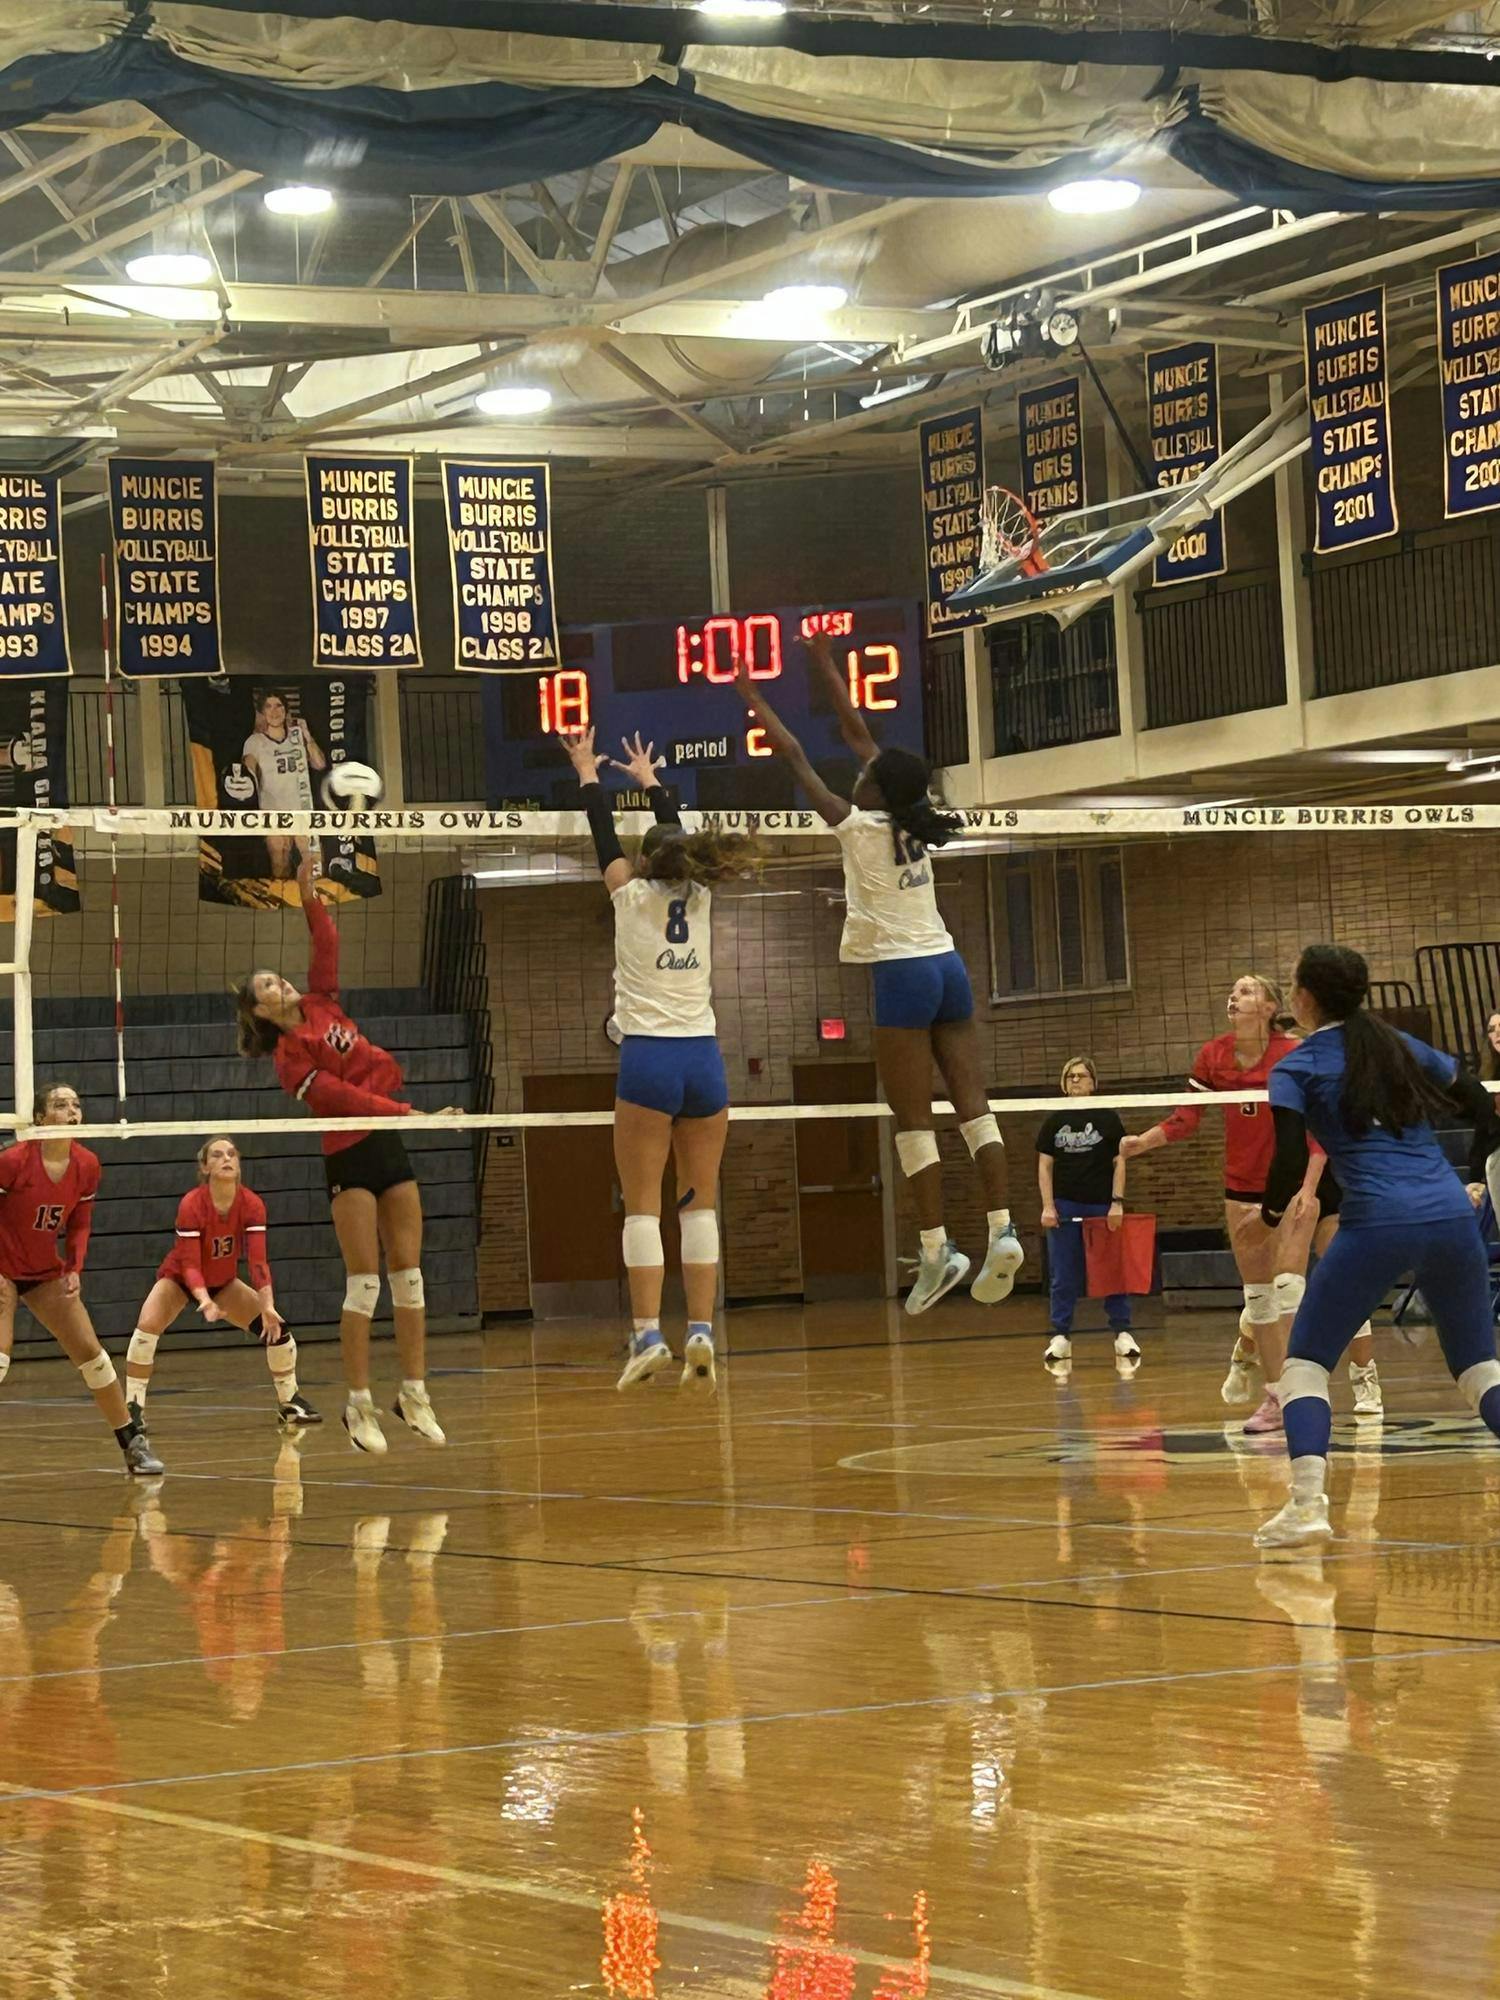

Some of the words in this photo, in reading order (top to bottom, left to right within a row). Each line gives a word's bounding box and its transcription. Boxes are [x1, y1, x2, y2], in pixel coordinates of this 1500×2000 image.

[1450, 272, 1500, 312] MUNC
[1315, 309, 1379, 351] MUNCIE
[1153, 357, 1209, 395] MUNCIE
[1323, 418, 1379, 456] STATE
[121, 475, 204, 500] MUNCIE
[320, 470, 396, 494] MUNCIE
[458, 476, 535, 501] MUNCIE
[122, 507, 203, 531] BURRIS
[322, 498, 398, 521] BURRIS
[460, 502, 537, 527] BURRIS
[1333, 492, 1374, 527] 2001
[933, 508, 976, 539] STATE
[311, 525, 409, 548] VOLLEYBALL
[451, 530, 545, 553] VOLLEYBALL
[116, 539, 214, 563] VOLLEYBALL
[327, 552, 396, 575] STATE
[470, 557, 535, 581] STATE
[130, 570, 200, 594] STATE
[322, 579, 407, 602] CHAMPS
[462, 584, 543, 607] CHAMPS
[124, 602, 212, 625] CHAMPS
[341, 607, 390, 630] 1997
[481, 611, 532, 634] 1998
[140, 634, 193, 658] 1994
[319, 633, 384, 657] CLASS
[389, 633, 416, 657] 2A
[461, 637, 523, 661] CLASS
[528, 638, 555, 660] 2A
[677, 614, 782, 684] 1:00
[847, 644, 900, 711] 12
[538, 670, 589, 735] 18
[675, 737, 727, 764] period
[170, 811, 295, 830] MUNCIE
[308, 811, 425, 830] BURRIS
[439, 811, 524, 830] OWLS
[701, 811, 814, 829] MUNCIE
[1183, 808, 1285, 826] MUNCIE
[1297, 808, 1394, 825] BURRIS
[1404, 807, 1475, 823] OWLS
[665, 899, 689, 945] 8
[33, 1204, 64, 1230] 15
[211, 1236, 235, 1259] 13
